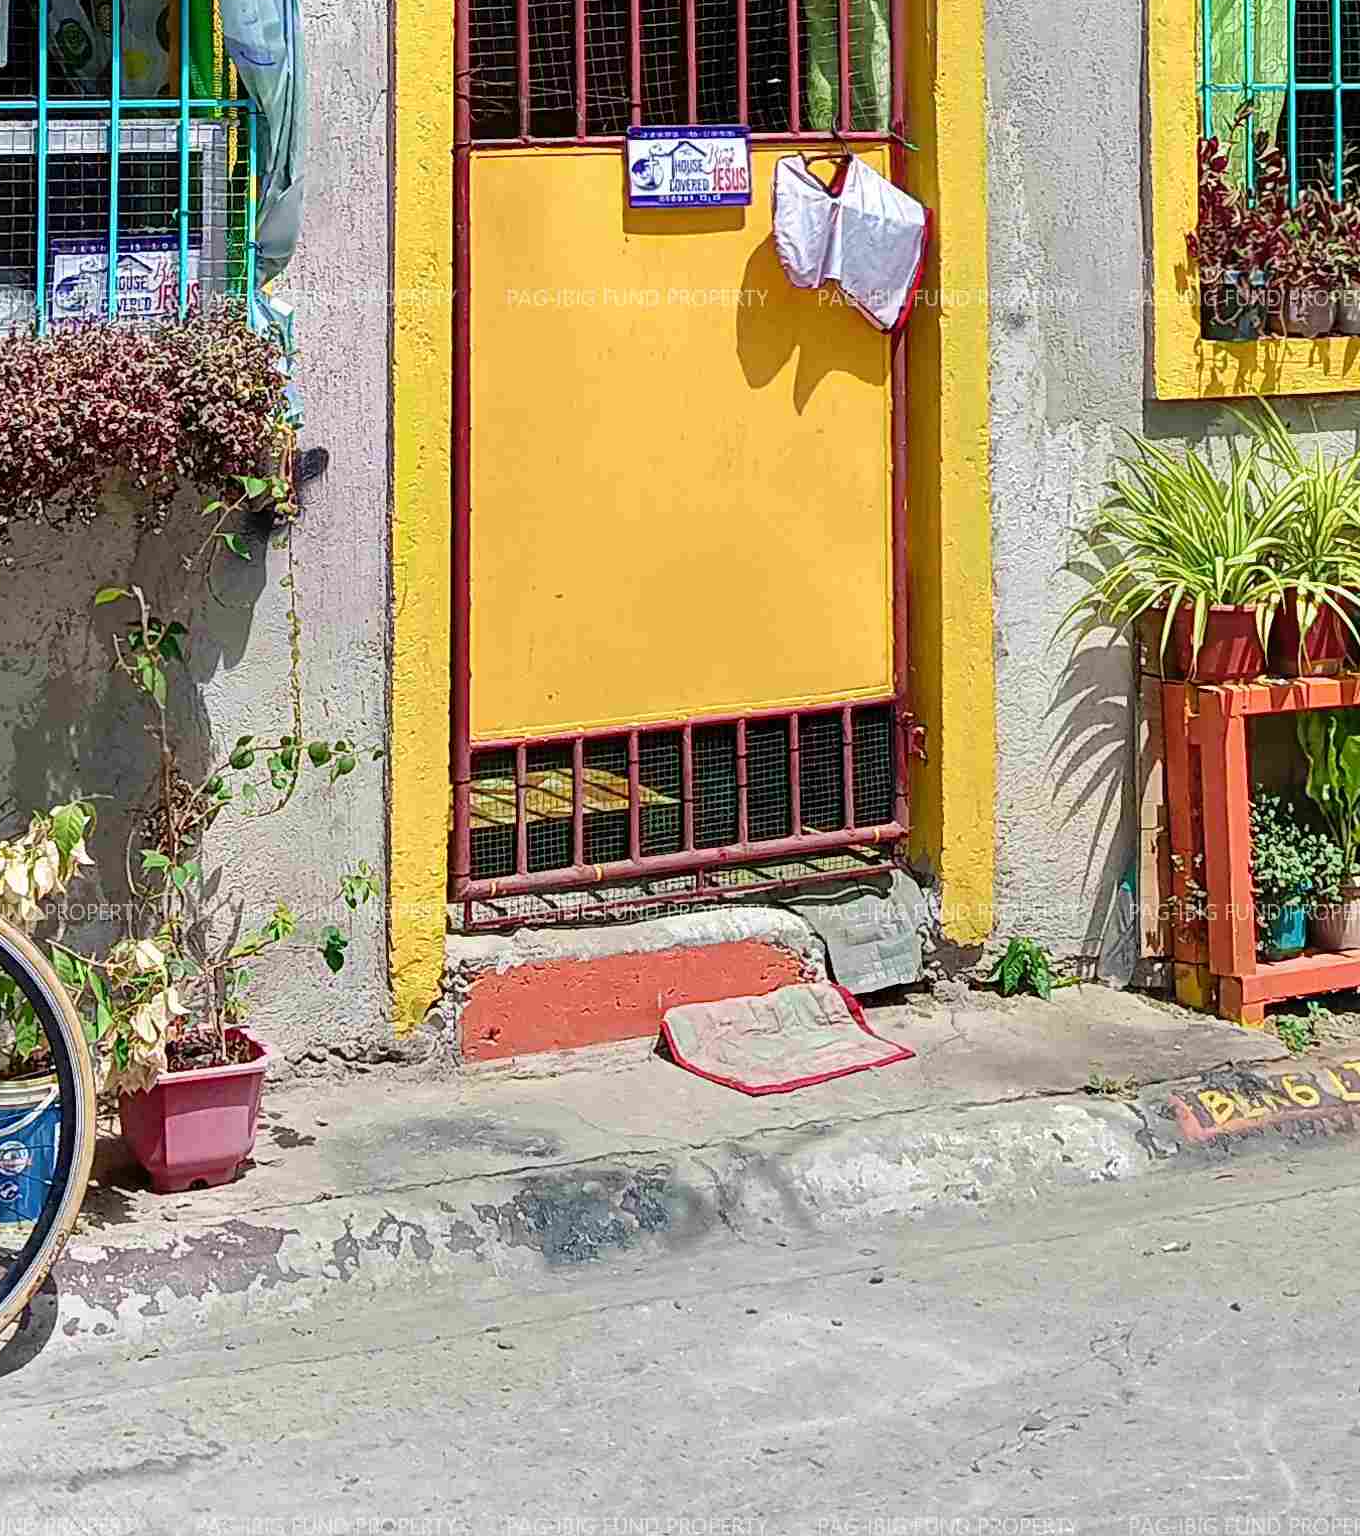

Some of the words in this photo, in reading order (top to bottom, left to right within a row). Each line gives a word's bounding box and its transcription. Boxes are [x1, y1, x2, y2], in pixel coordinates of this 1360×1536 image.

[673, 159, 703, 174] HOUSE
[712, 167, 748, 192] JESUS
[114, 274, 149, 291] OUSE
